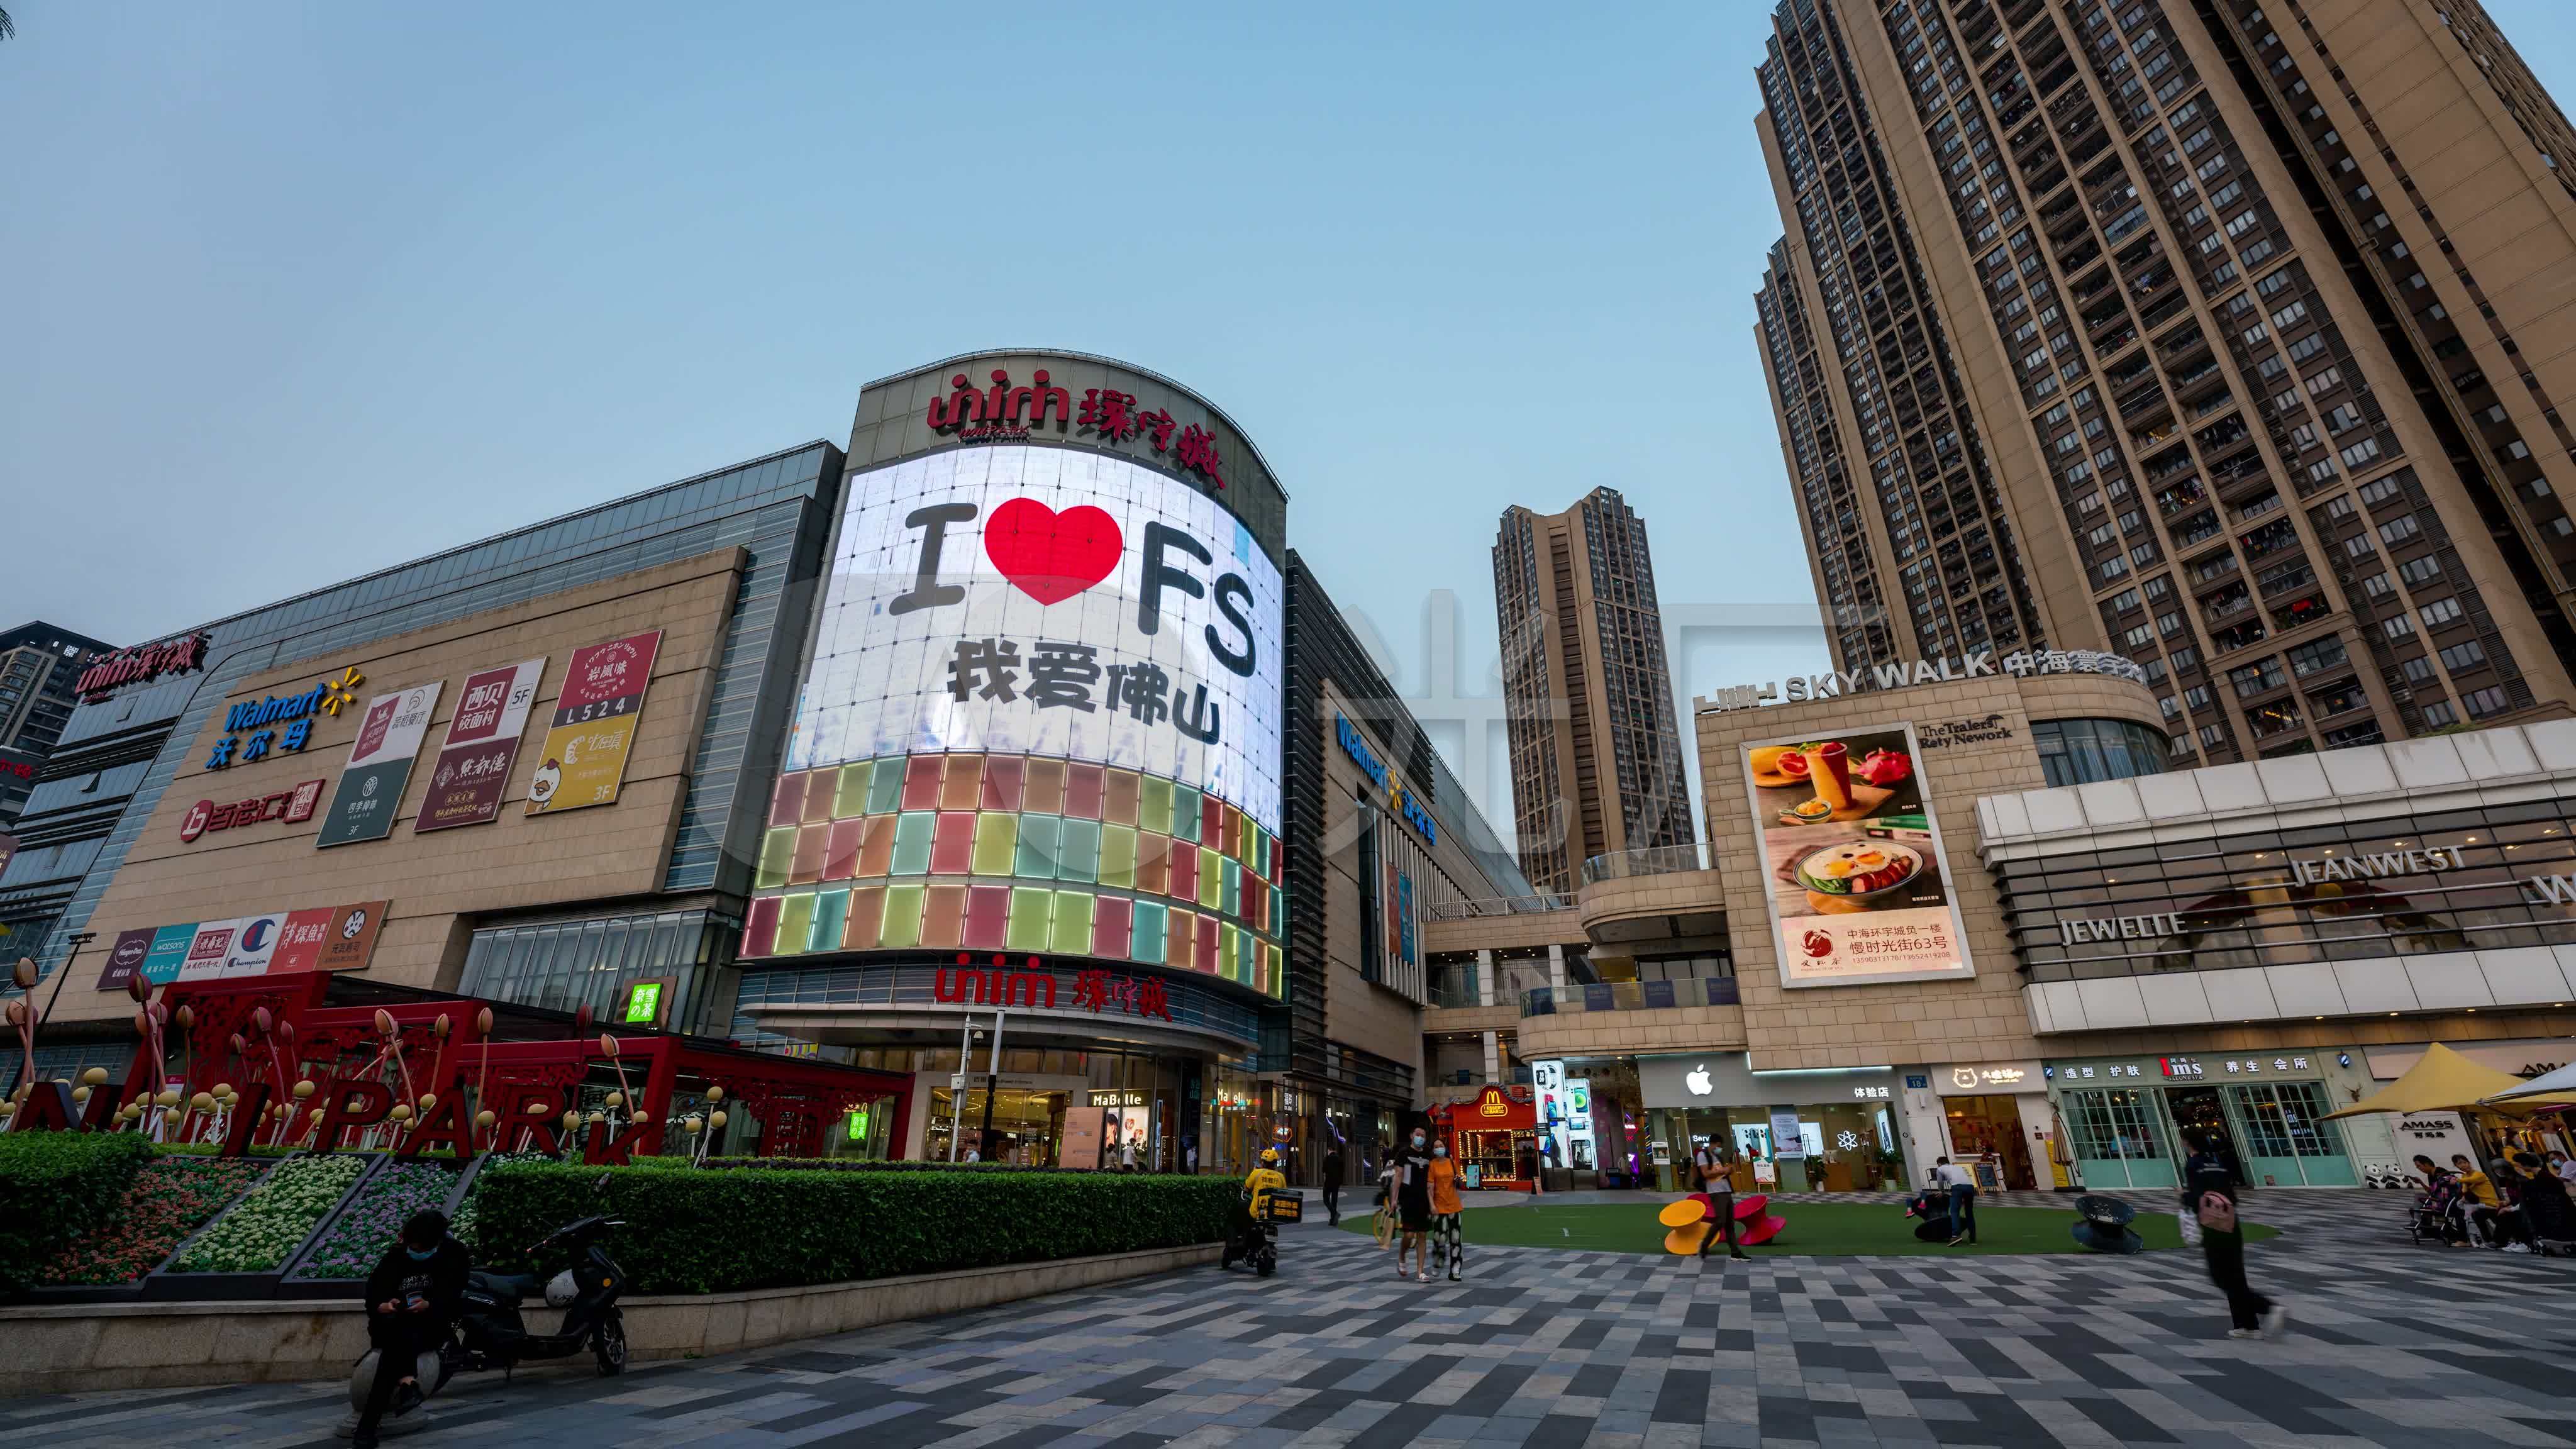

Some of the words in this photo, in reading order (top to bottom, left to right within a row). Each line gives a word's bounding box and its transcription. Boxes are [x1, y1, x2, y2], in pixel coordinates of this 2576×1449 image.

[889, 503, 978, 616] I
[1137, 521, 1256, 678] FS
[1787, 668, 1860, 702] SKY
[1874, 652, 1995, 690] WALK
[465, 681, 505, 711] 西贝
[511, 689, 530, 705] 5F
[948, 638, 1220, 745] 我爱佛山
[224, 683, 326, 732] Walmart
[457, 709, 497, 731] 莜面村
[204, 719, 313, 769] 沃尔玛
[1336, 712, 1389, 796] Walmart
[348, 825, 360, 835] 3F
[2292, 845, 2465, 887] JEANWEST
[1847, 923, 1943, 939] 中海环宇城负一楼
[2058, 912, 2189, 947] JEWELLE
[1850, 936, 1948, 955] 慢时光街63号
[228, 957, 267, 969] Champion
[2065, 1067, 2095, 1079] 造型
[2109, 1065, 2140, 1077] 护肤
[2225, 1060, 2259, 1074] 养生
[2274, 1057, 2307, 1070] 会所
[1854, 1086, 1889, 1097] 体验店
